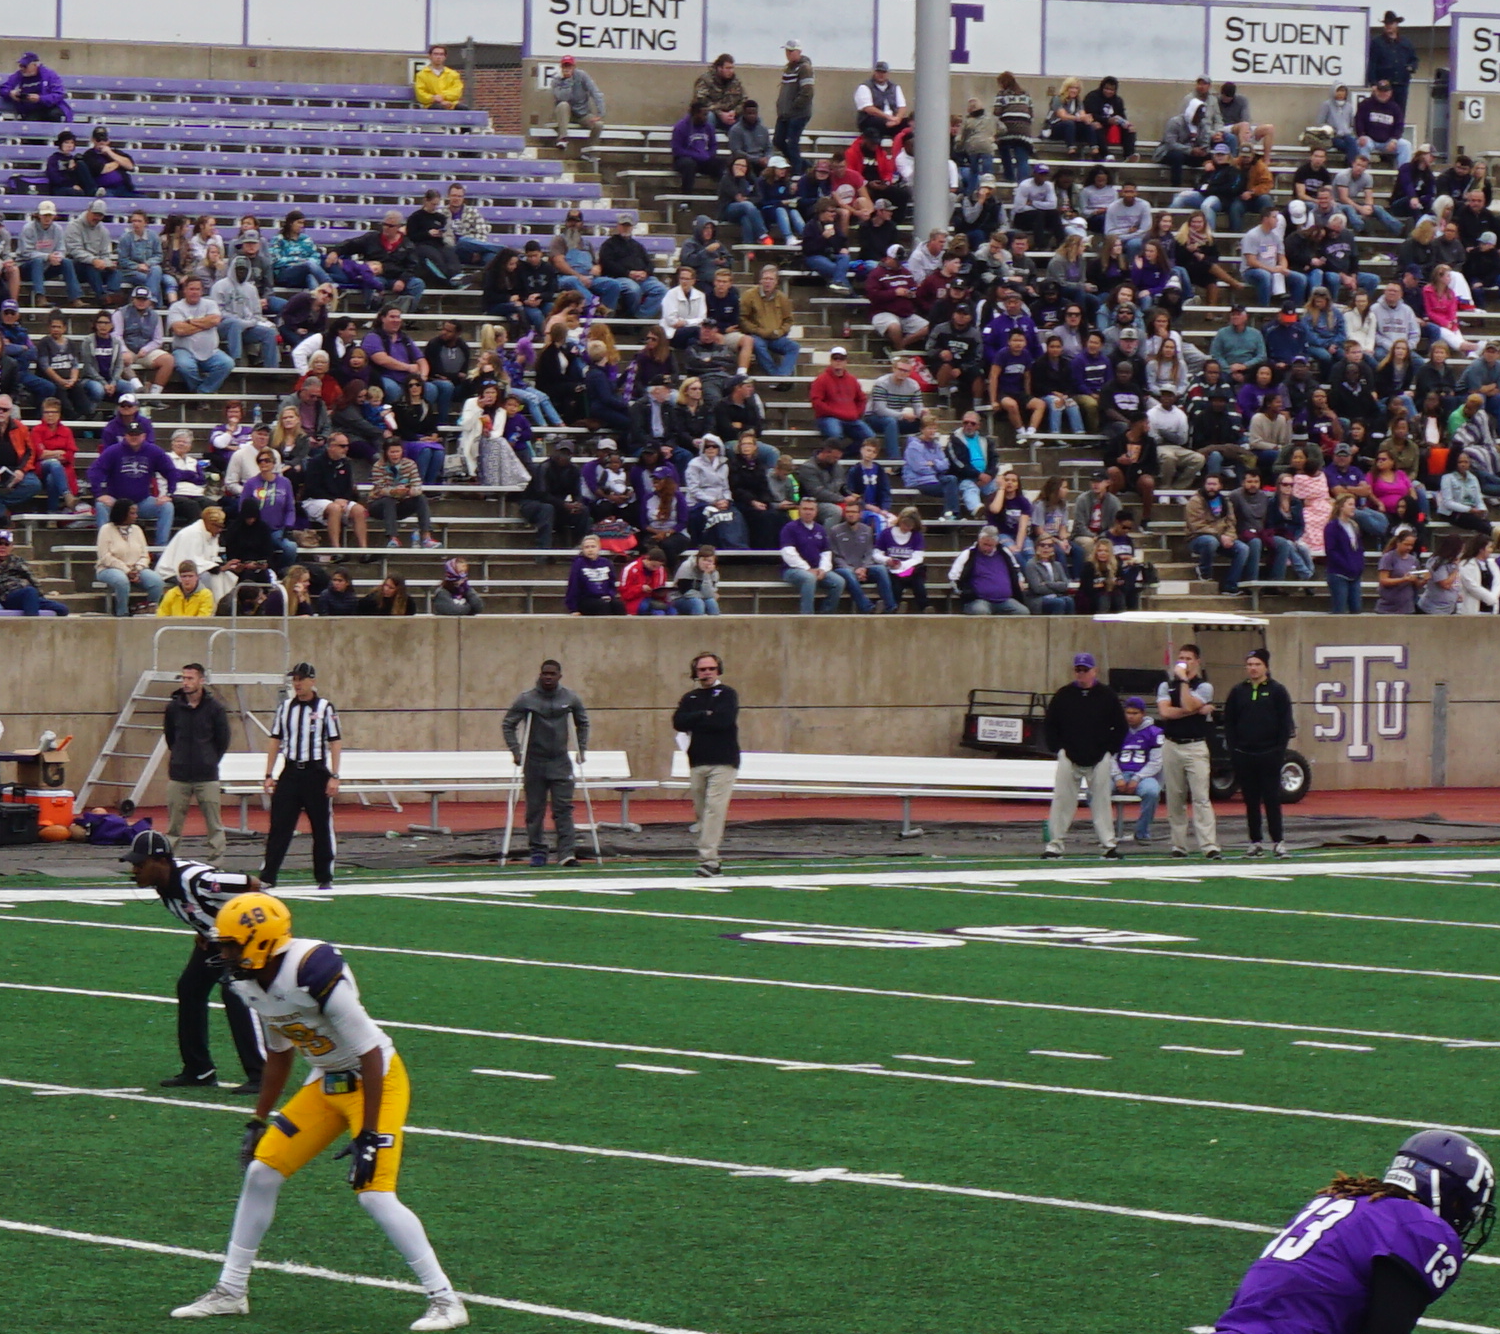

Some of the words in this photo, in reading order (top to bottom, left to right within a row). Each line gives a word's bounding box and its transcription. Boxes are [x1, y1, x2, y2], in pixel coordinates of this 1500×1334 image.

[556, 21, 677, 52] SEATING
[1225, 16, 1350, 46] STUDENT
[1231, 47, 1342, 76] SEATING
[1469, 99, 1482, 119] G
[1424, 1243, 1459, 1289] 13
